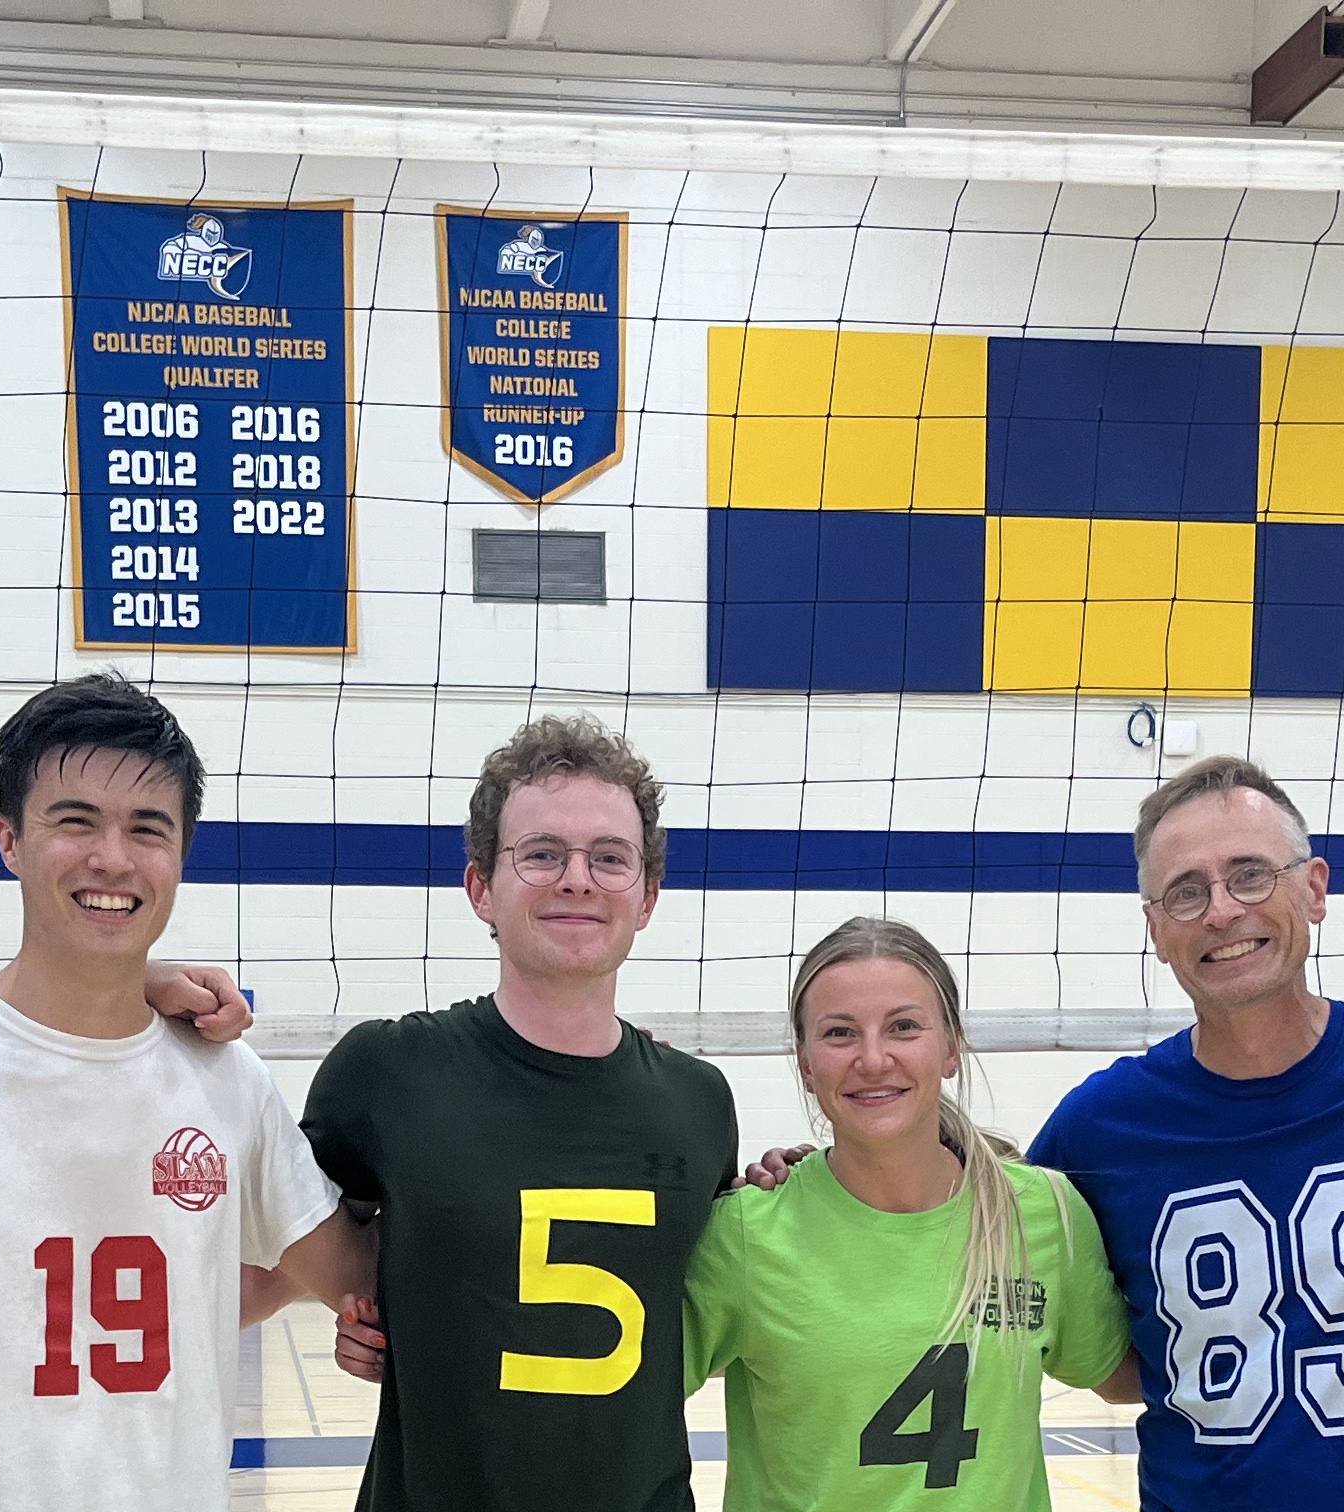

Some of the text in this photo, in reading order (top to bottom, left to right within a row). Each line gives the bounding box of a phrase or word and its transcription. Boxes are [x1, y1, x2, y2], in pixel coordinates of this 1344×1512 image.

[164, 253, 227, 277] NECC
[501, 255, 546, 272] NECC
[128, 302, 292, 327] NJCAA BASEBALL
[460, 287, 608, 312] NJCAA BASEBALL
[496, 319, 571, 339] COLLEGE
[93, 332, 326, 360] COLLEGE WORLD SERIES
[467, 346, 600, 369] WORLD SERIES
[164, 366, 259, 389] QUALIFER
[490, 376, 578, 397] NATIONAL
[103, 401, 199, 438] 2006
[232, 406, 320, 442] 2016
[483, 404, 584, 426] RUNNER-UP
[494, 434, 573, 467] 2016
[108, 450, 197, 486] 2012
[232, 453, 320, 490] 2018
[109, 497, 198, 534] 2013
[233, 499, 324, 535] 2022
[111, 545, 199, 581] 2014
[113, 593, 200, 628] 2015
[153, 1152, 226, 1181] SLAM
[158, 1182, 224, 1194] VOLLEYBALL
[500, 1189, 656, 1395] 5
[34, 1235, 171, 1396] 19
[859, 1342, 978, 1489] 4
